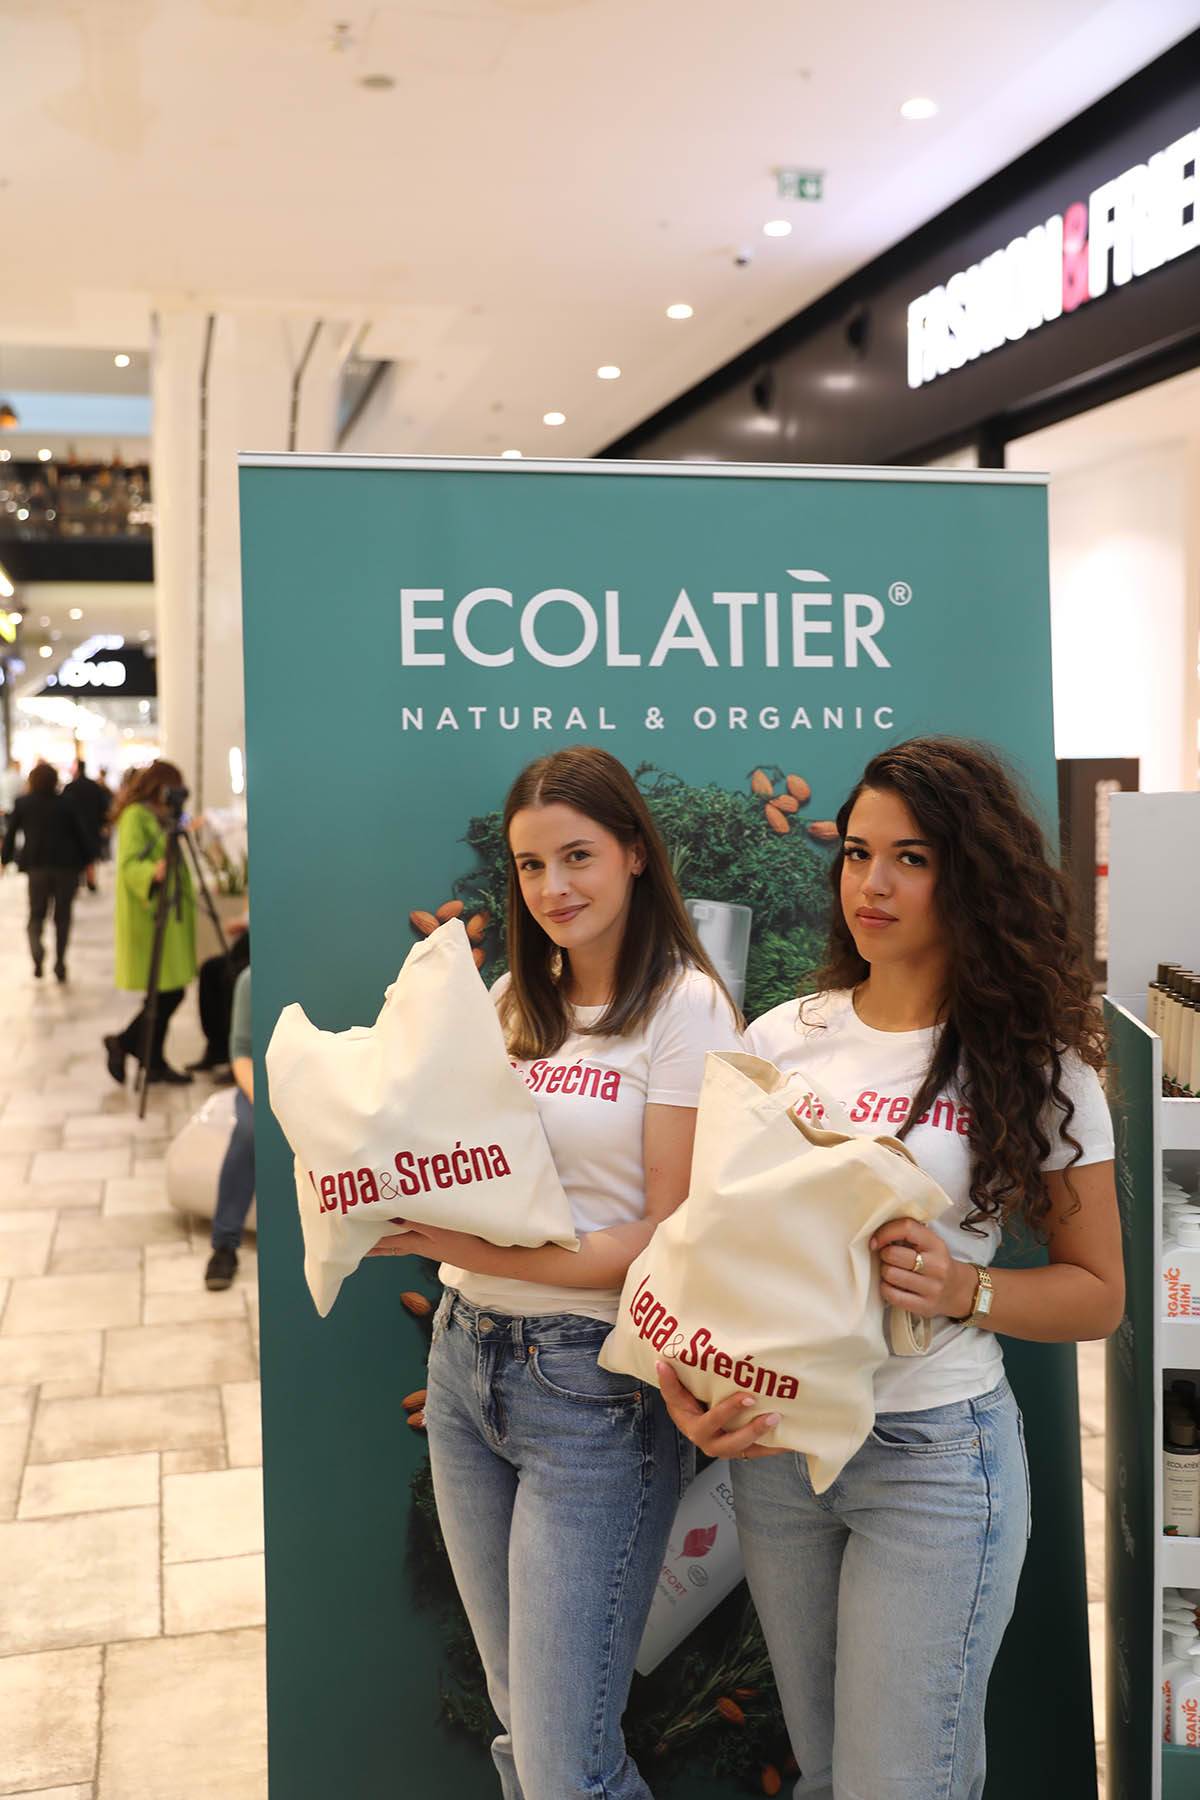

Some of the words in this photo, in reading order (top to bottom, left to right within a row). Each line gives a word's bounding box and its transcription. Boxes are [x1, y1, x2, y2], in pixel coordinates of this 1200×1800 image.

[402, 706, 616, 730] NATURAL
[645, 706, 664, 729] &
[693, 706, 894, 730] ORGANIC
[849, 1091, 975, 1135] Srena
